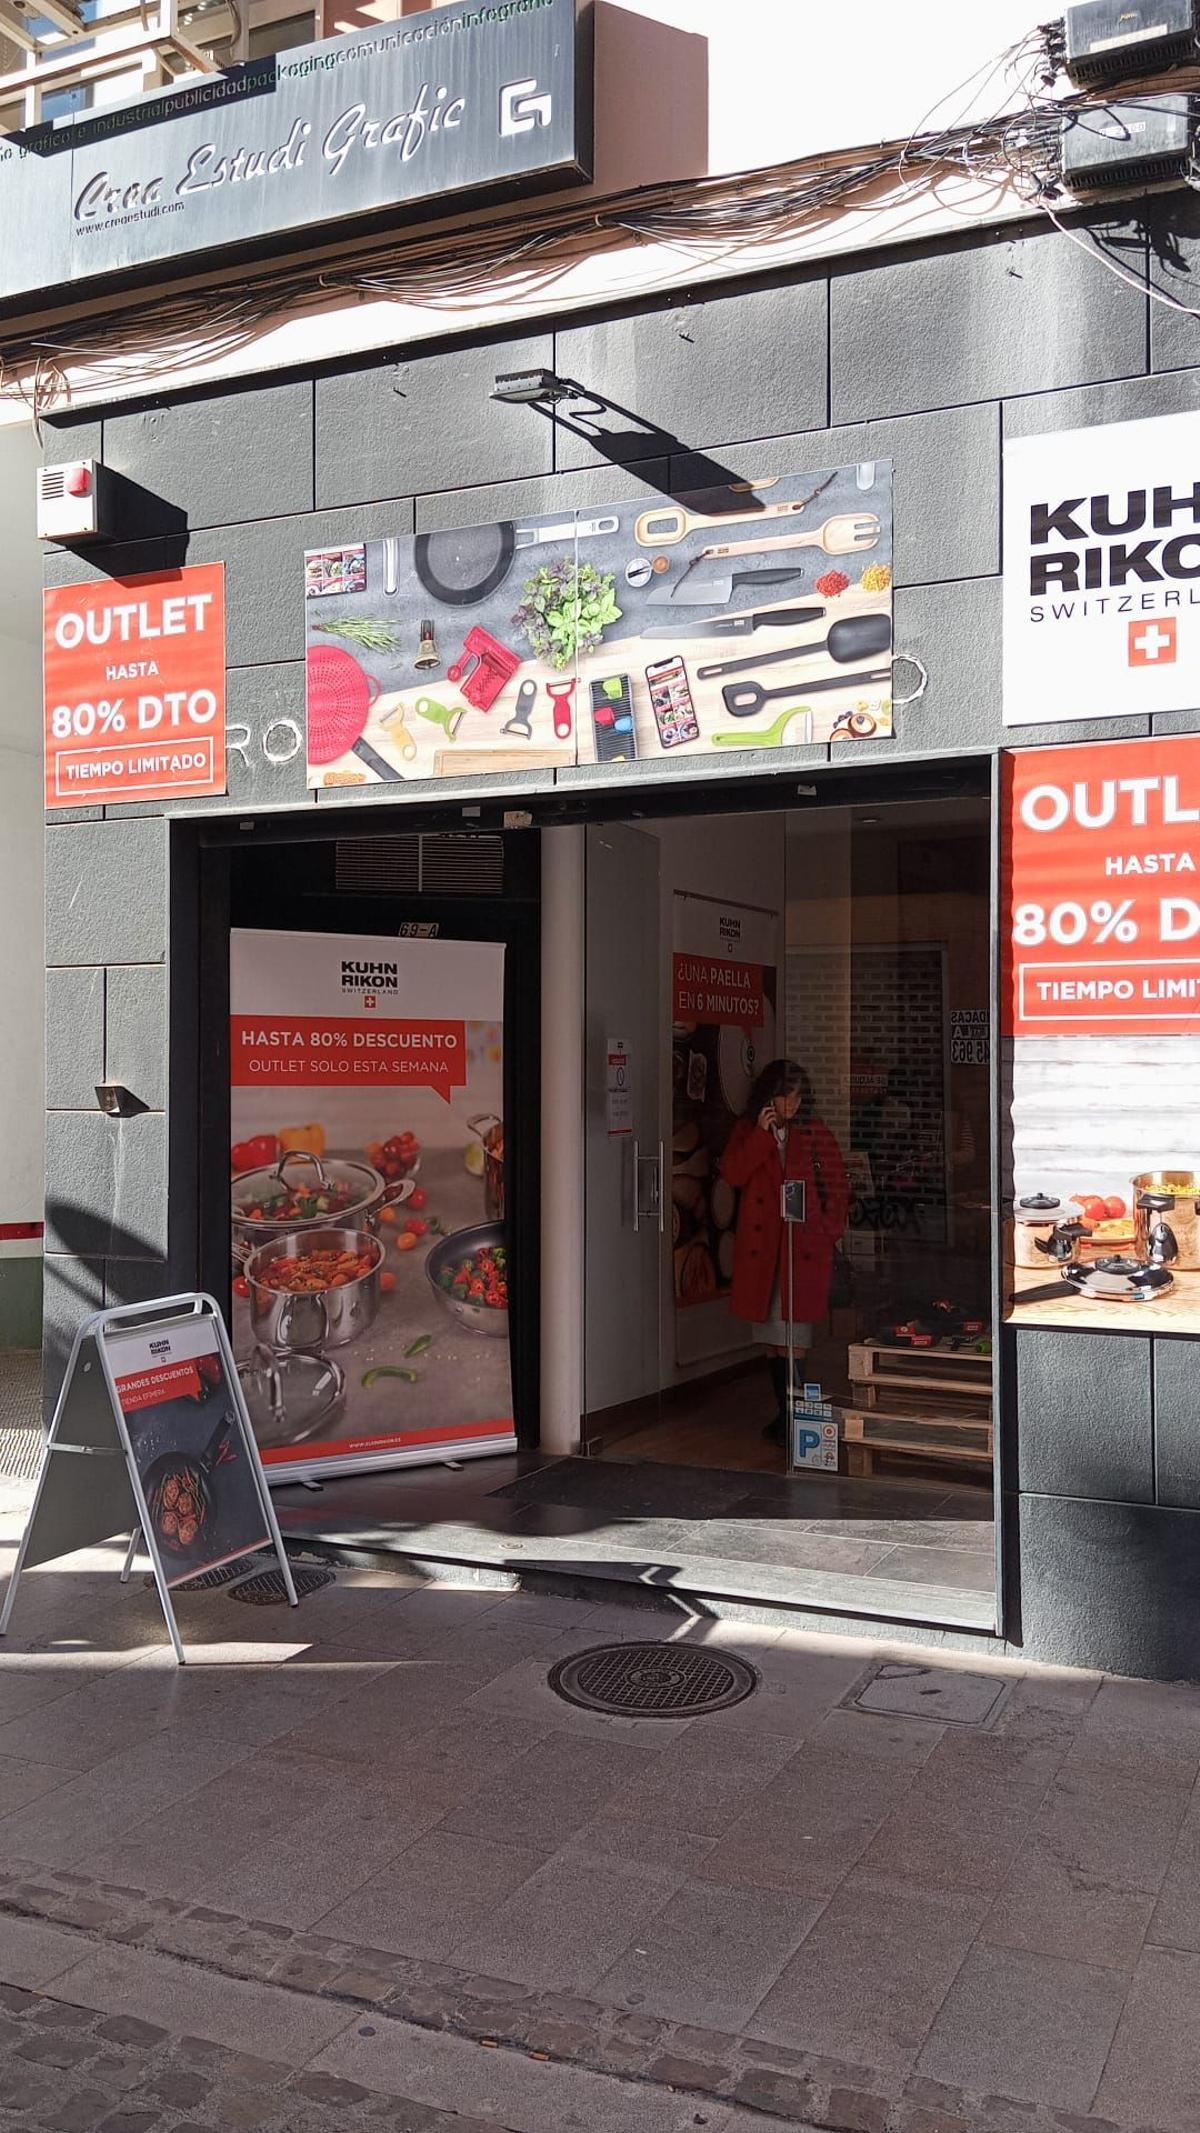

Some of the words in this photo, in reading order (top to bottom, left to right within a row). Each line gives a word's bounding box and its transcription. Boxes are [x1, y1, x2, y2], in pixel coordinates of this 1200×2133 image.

[74, 171, 163, 221] Crea
[176, 117, 310, 197] Estudi
[322, 82, 466, 175] Grafic
[75, 201, 185, 236] www.creaestudi.com
[54, 593, 213, 649] OUTLET
[106, 661, 159, 680] HASTA
[52, 699, 126, 738] 80%
[138, 689, 217, 730] DTO
[65, 761, 124, 780] TIEMPO
[128, 752, 207, 776] LIMITADO
[1021, 775, 1200, 833] OUTL
[1105, 852, 1196, 876] HASTA
[400, 923, 439, 938] 69-A
[720, 917, 740, 928] KUHN
[1013, 899, 1138, 946] 80%
[341, 961, 398, 975] KUHN
[678, 962, 707, 983] ¿UNA
[710, 967, 751, 989] PAELLA
[341, 975, 398, 988] RIKON
[1036, 980, 1134, 1001] TIEMPO
[679, 991, 695, 1009] EN
[697, 994, 703, 1010] 6
[706, 995, 760, 1016] MINUTOS?
[242, 1030, 304, 1046] HASTA
[310, 1032, 348, 1047] 80%
[353, 1033, 457, 1049] DESCUENTO
[249, 1059, 306, 1073] OUTLET
[310, 1060, 349, 1073] SOLO
[353, 1061, 388, 1073] ESTA
[391, 1061, 449, 1073] SEMANA
[116, 1379, 151, 1393] GRANDES
[151, 1367, 194, 1383] DESCUENTOS
[799, 1429, 820, 1458] P
